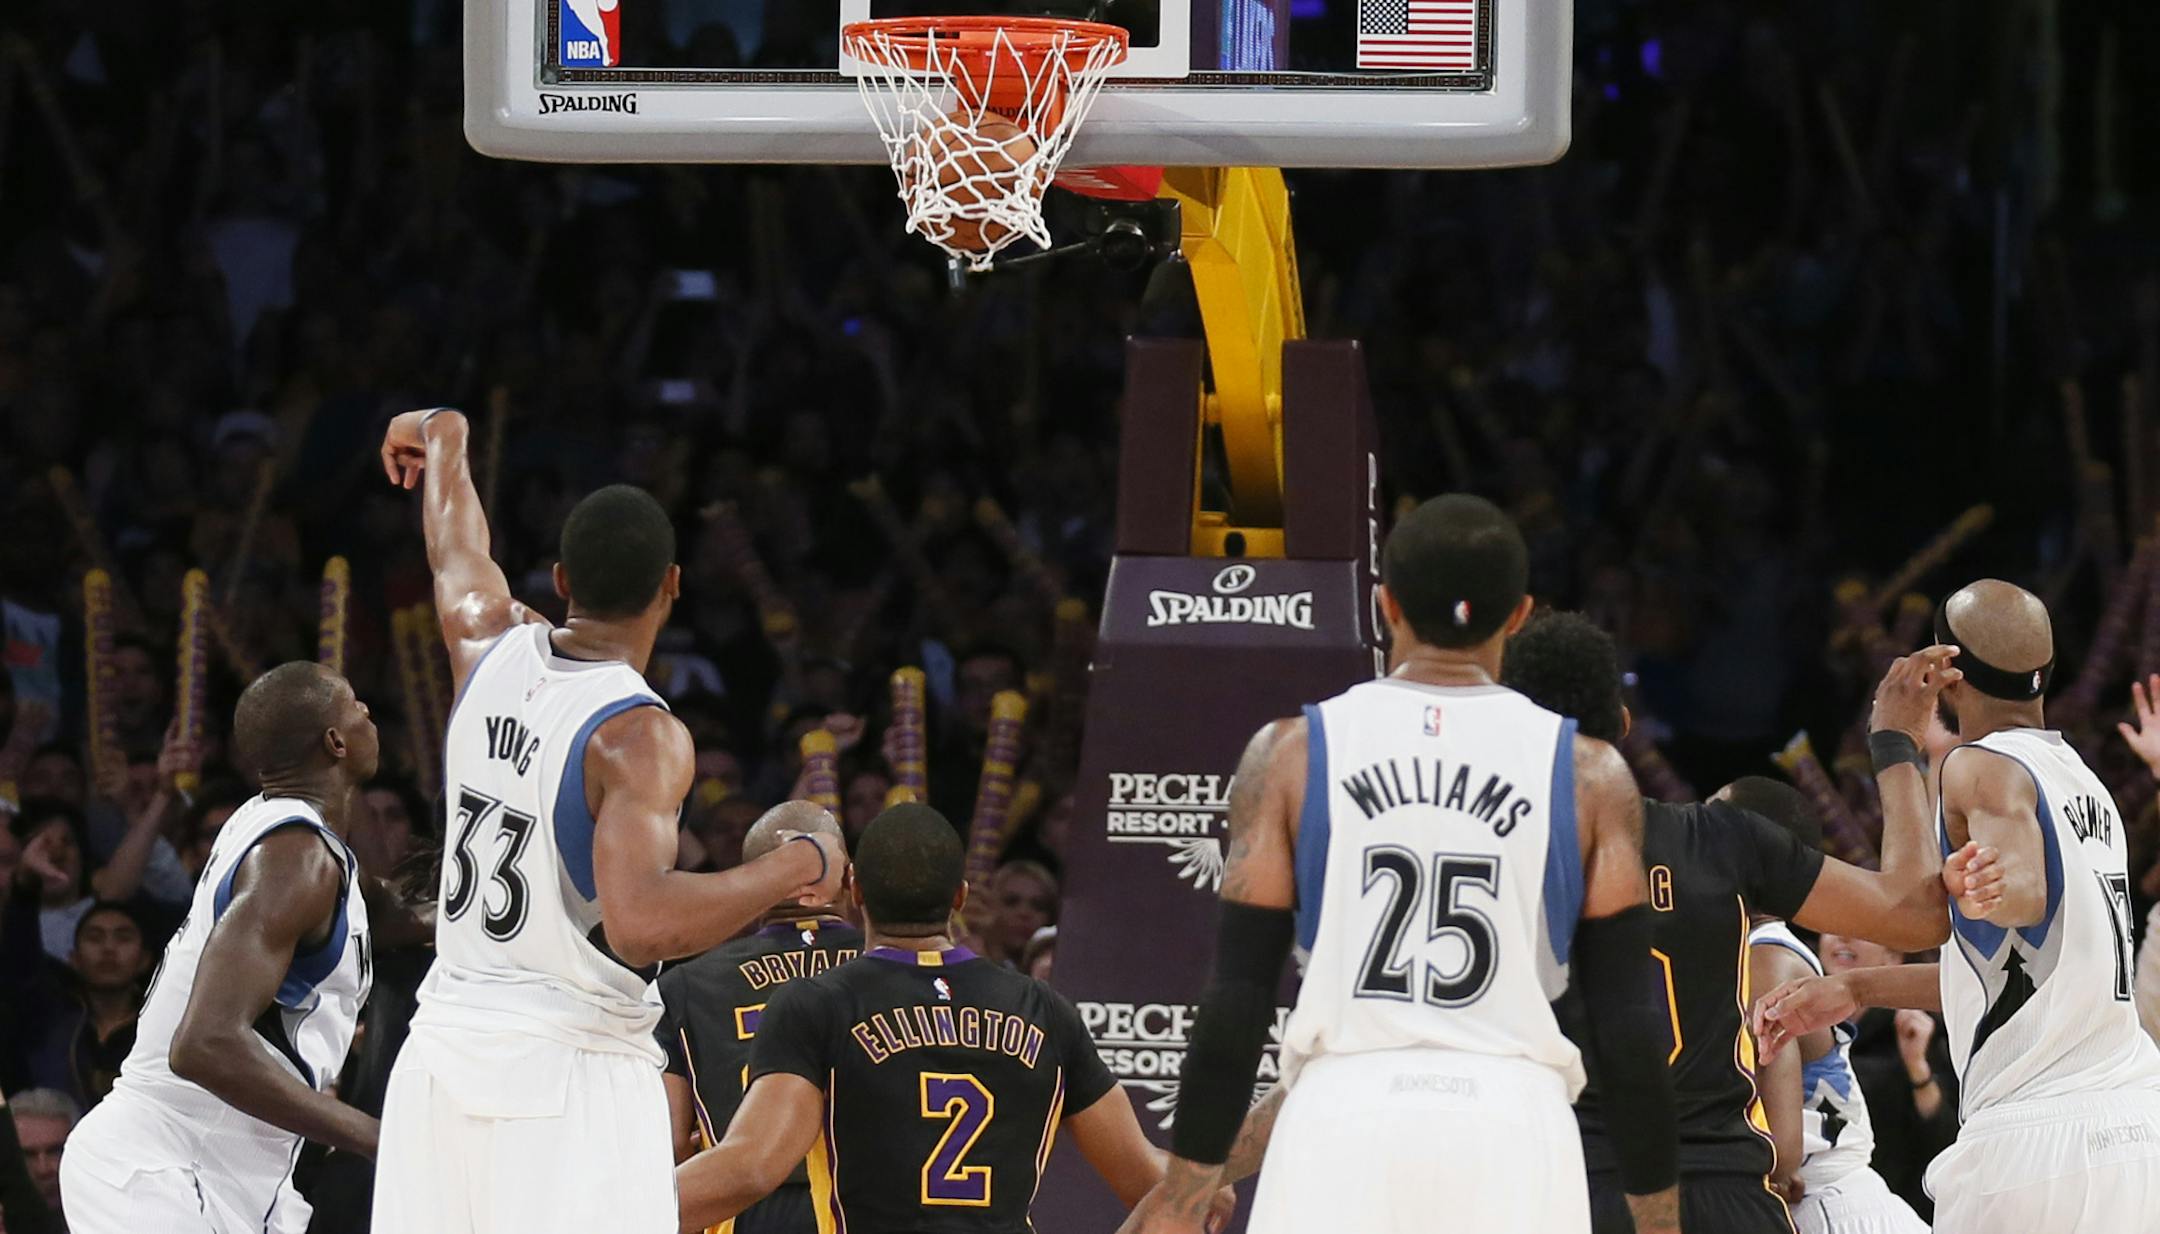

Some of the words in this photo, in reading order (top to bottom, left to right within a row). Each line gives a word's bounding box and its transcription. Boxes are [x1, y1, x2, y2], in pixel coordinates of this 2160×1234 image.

[567, 40, 600, 60] NBA
[538, 93, 638, 115] SPALDING
[1147, 589, 1315, 629] SPALDING
[1107, 811, 1214, 834] RESORT
[1341, 756, 1532, 838] WILLIAMS
[444, 784, 537, 942] 33
[1353, 843, 1500, 1008] 25
[851, 1005, 1045, 1069] ELLINGTON
[1097, 1048, 1187, 1075] ESOR
[919, 1071, 995, 1207] 2
